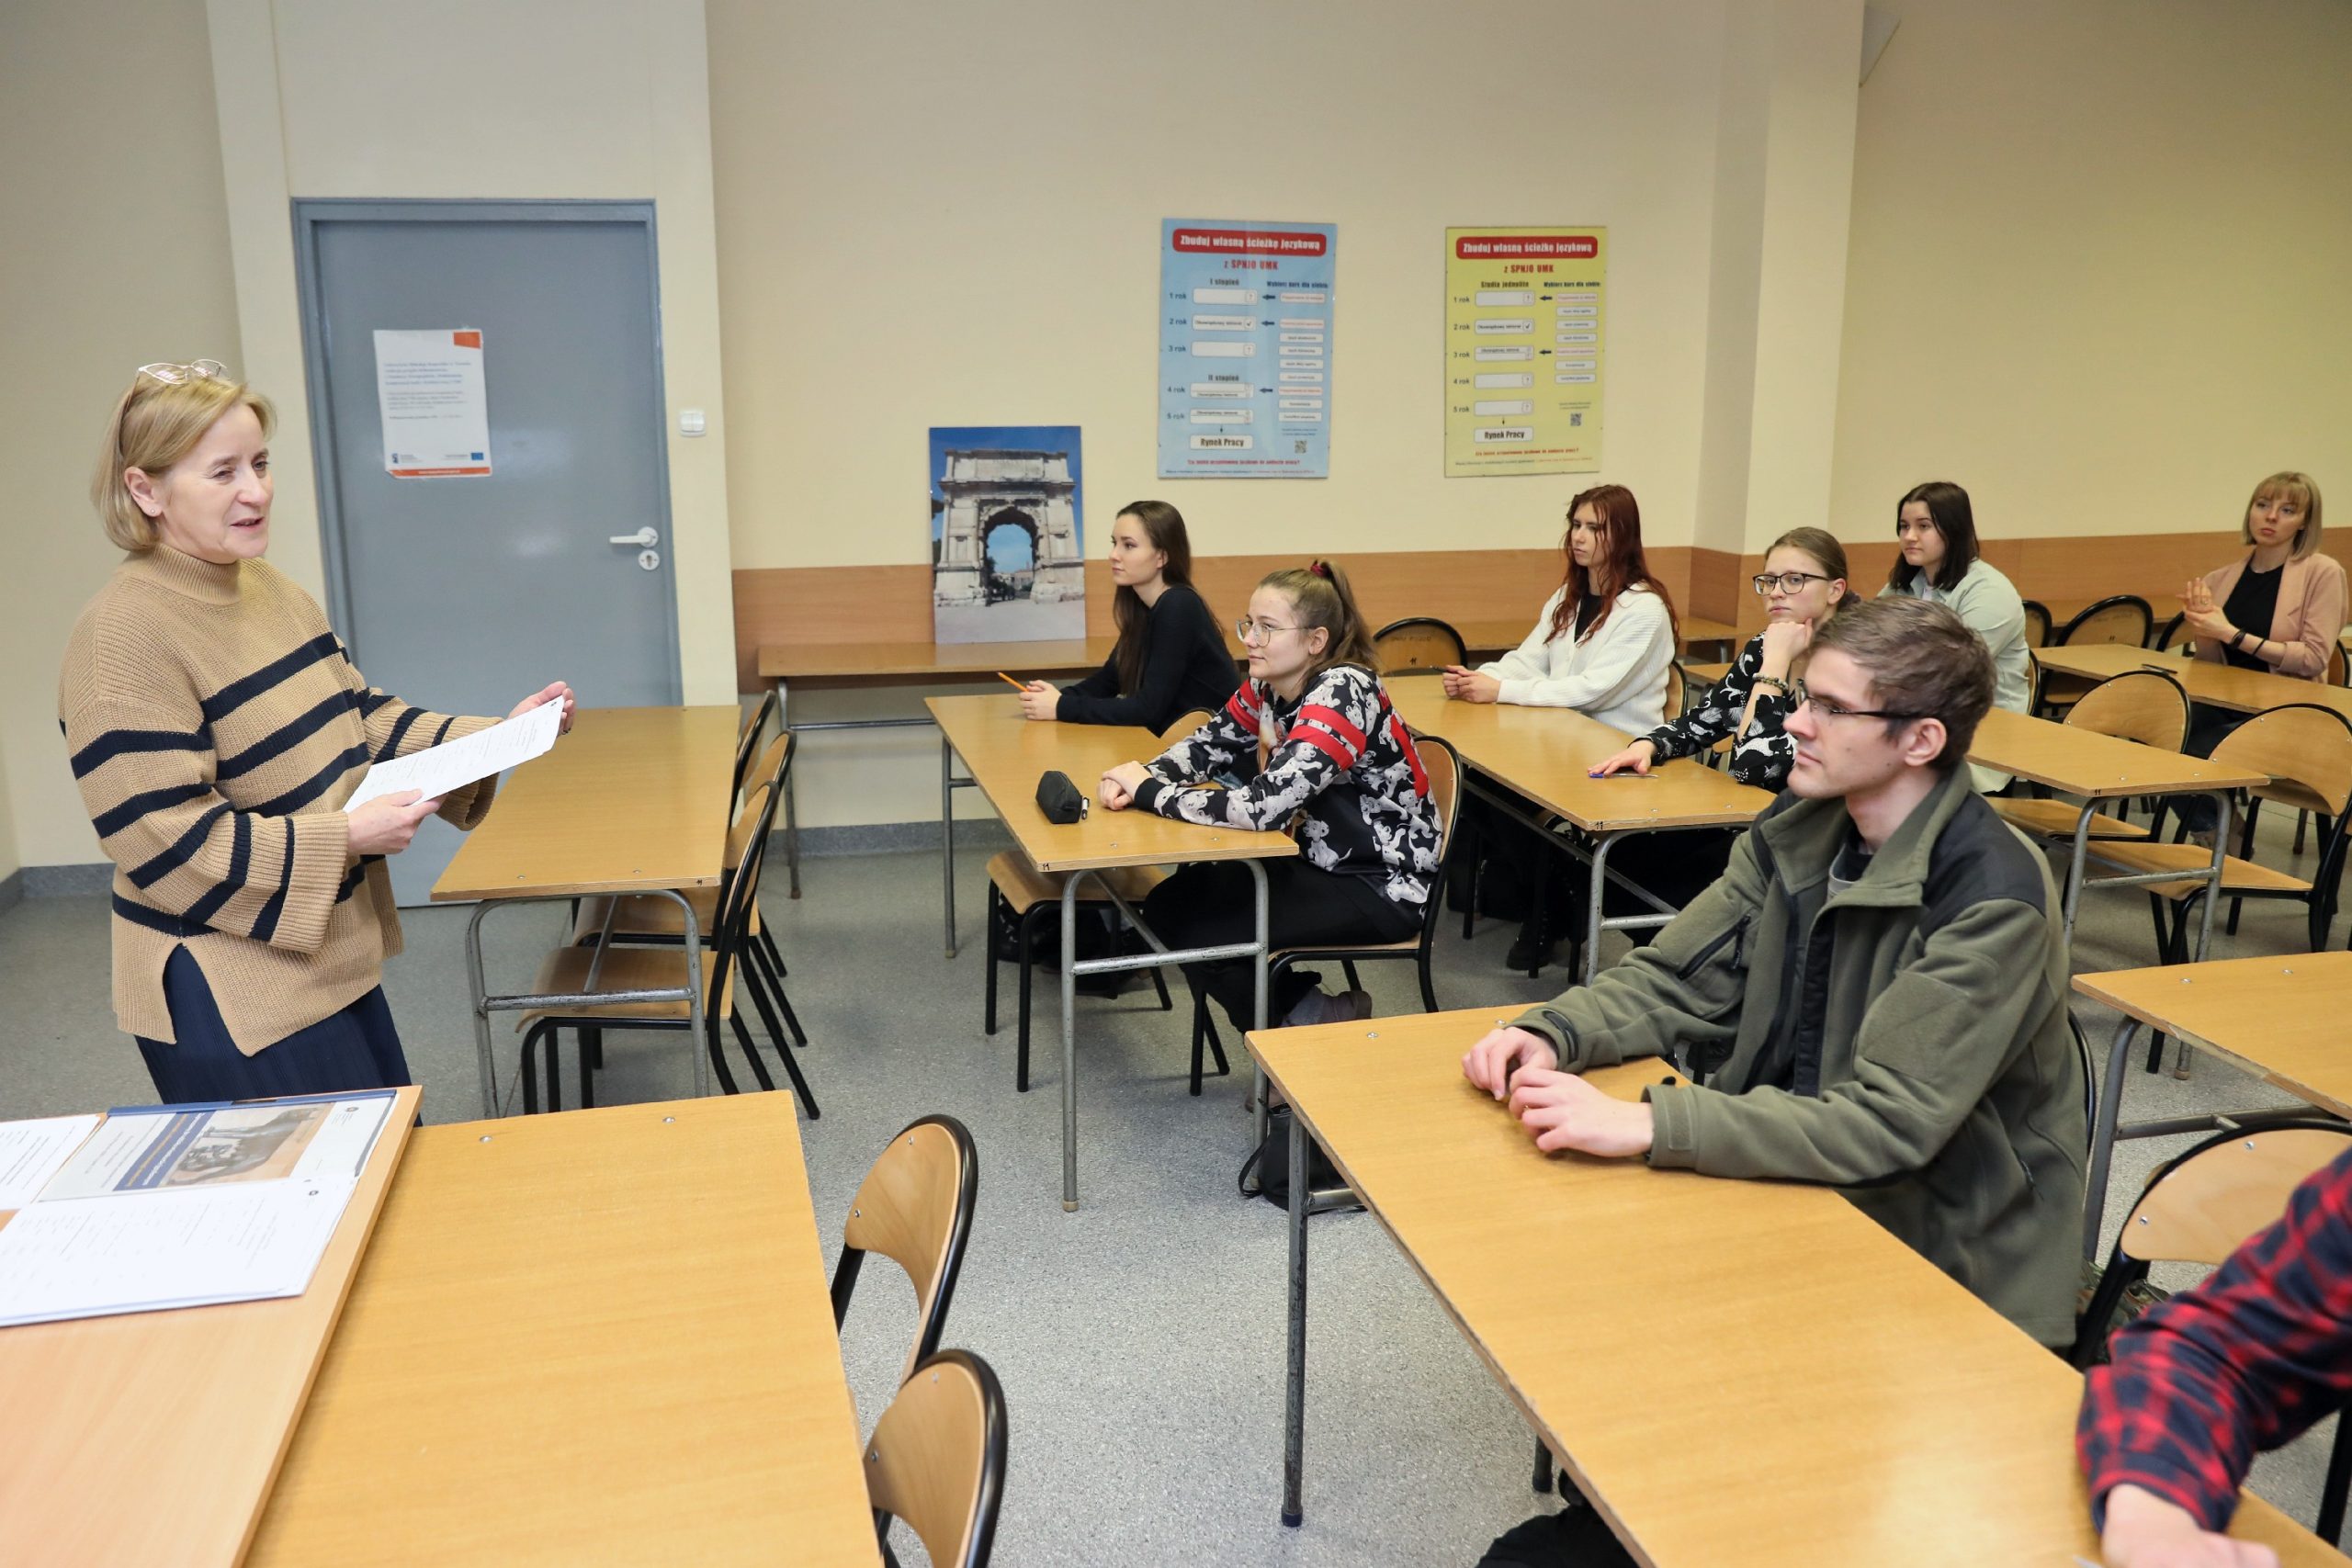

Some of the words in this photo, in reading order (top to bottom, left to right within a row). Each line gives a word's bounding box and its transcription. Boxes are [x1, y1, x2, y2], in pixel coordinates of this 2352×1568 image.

[1181, 235, 1210, 247] Zbuduj
[1213, 236, 1244, 249] własną
[1247, 236, 1278, 250] ścieżkę
[1281, 238, 1320, 251] językową
[1463, 243, 1491, 254] Zbuduj
[1493, 243, 1522, 254] własną
[1525, 242, 1555, 254] ścieżkę
[1556, 243, 1593, 254] językową
[1260, 260, 1279, 270] UMK
[1537, 265, 1555, 273] UMK
[1484, 431, 1505, 439] Rynek
[1506, 430, 1525, 439] Pracy
[1201, 437, 1222, 446] Rynek
[1224, 438, 1244, 447] Pracy
